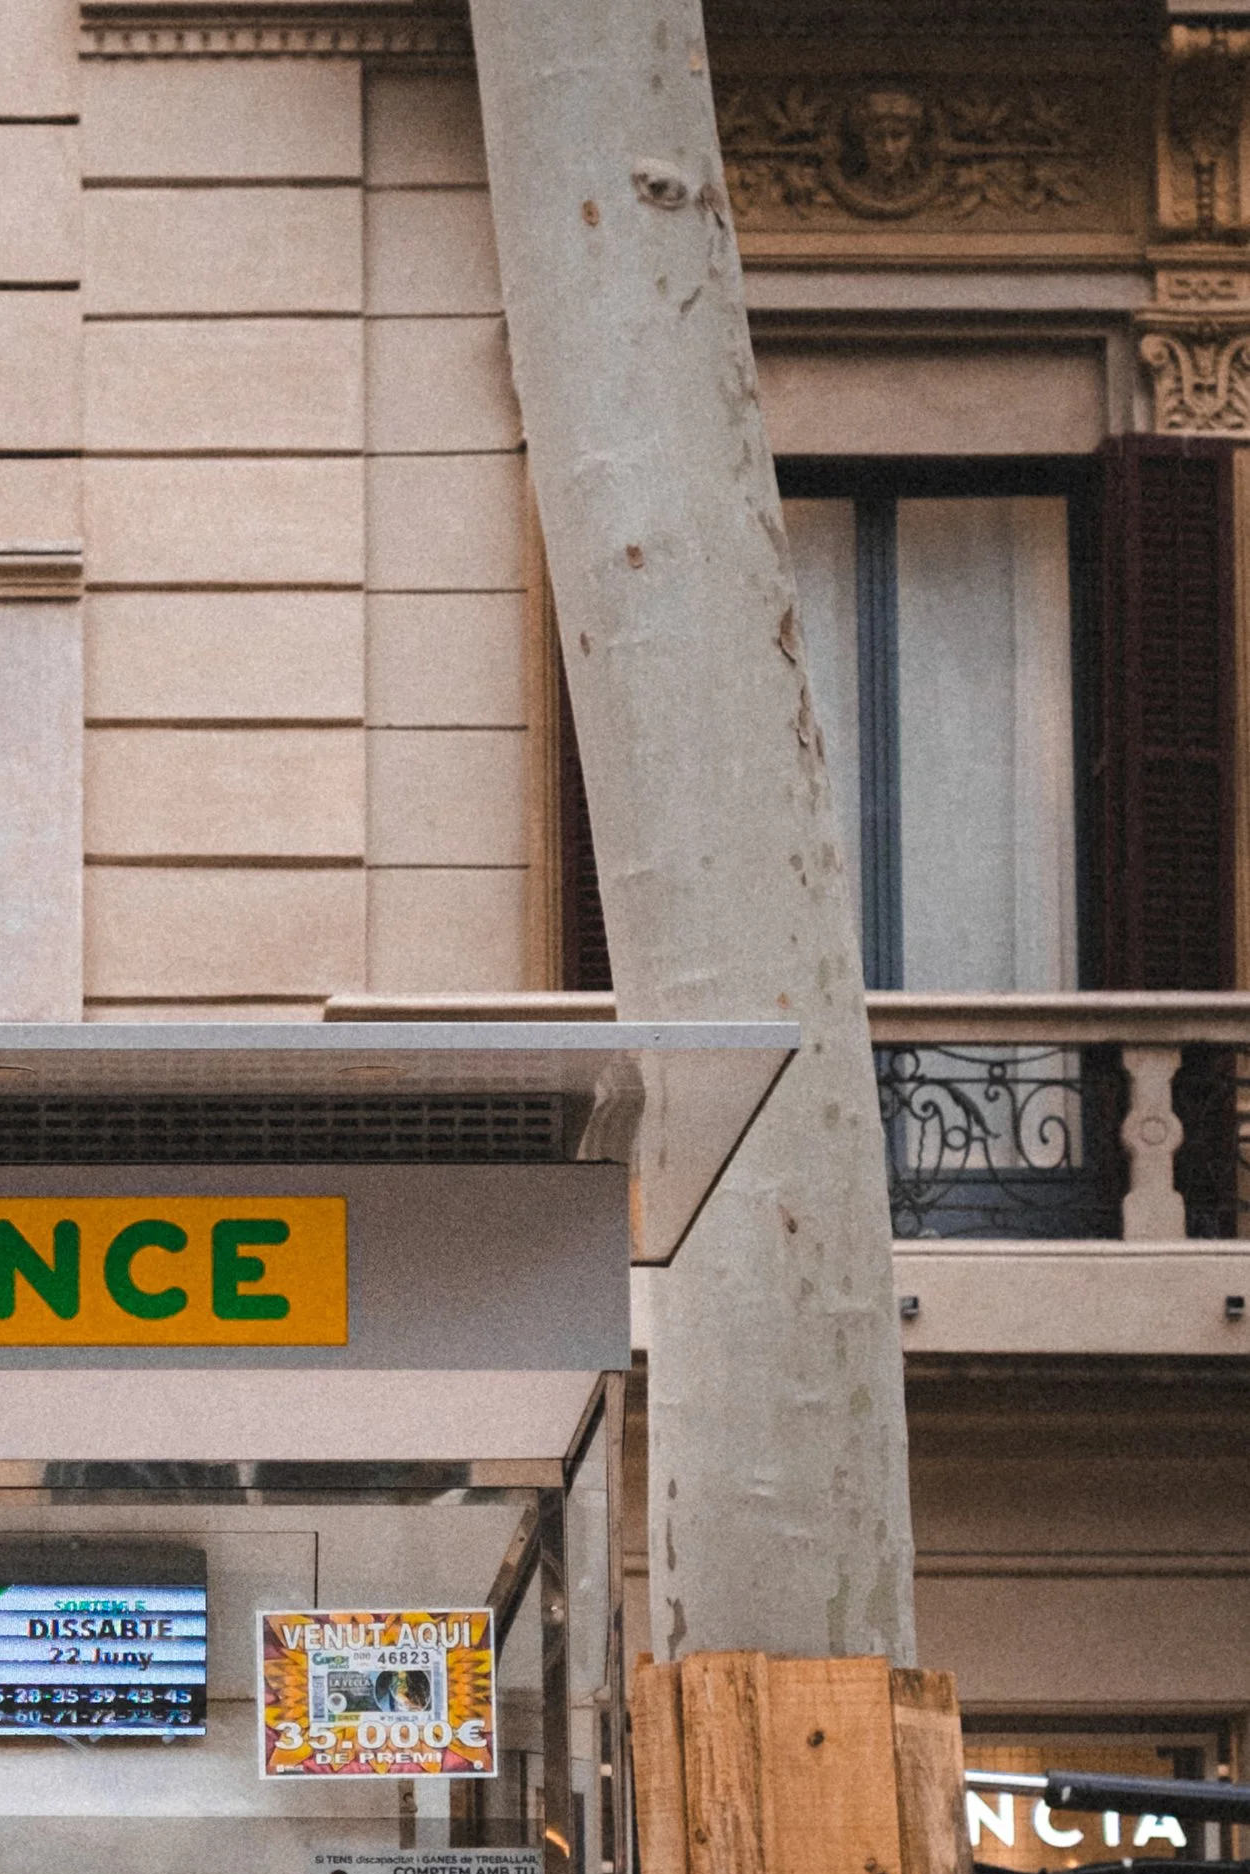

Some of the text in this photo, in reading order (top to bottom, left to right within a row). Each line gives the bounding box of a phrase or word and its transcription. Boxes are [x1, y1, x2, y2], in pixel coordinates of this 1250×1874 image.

[27, 1618, 175, 1640] DISSABTE
[282, 1615, 471, 1650] VENUT AQUÍ
[49, 1647, 154, 1671] 22 Juny
[377, 1651, 430, 1664] 46823
[274, 1719, 488, 1750] 35.000€
[316, 1751, 442, 1764] DE PREMI
[326, 1856, 353, 1864] TENS
[356, 1855, 414, 1866] discapacitat
[422, 1856, 458, 1864] GANES
[460, 1855, 473, 1864] de
